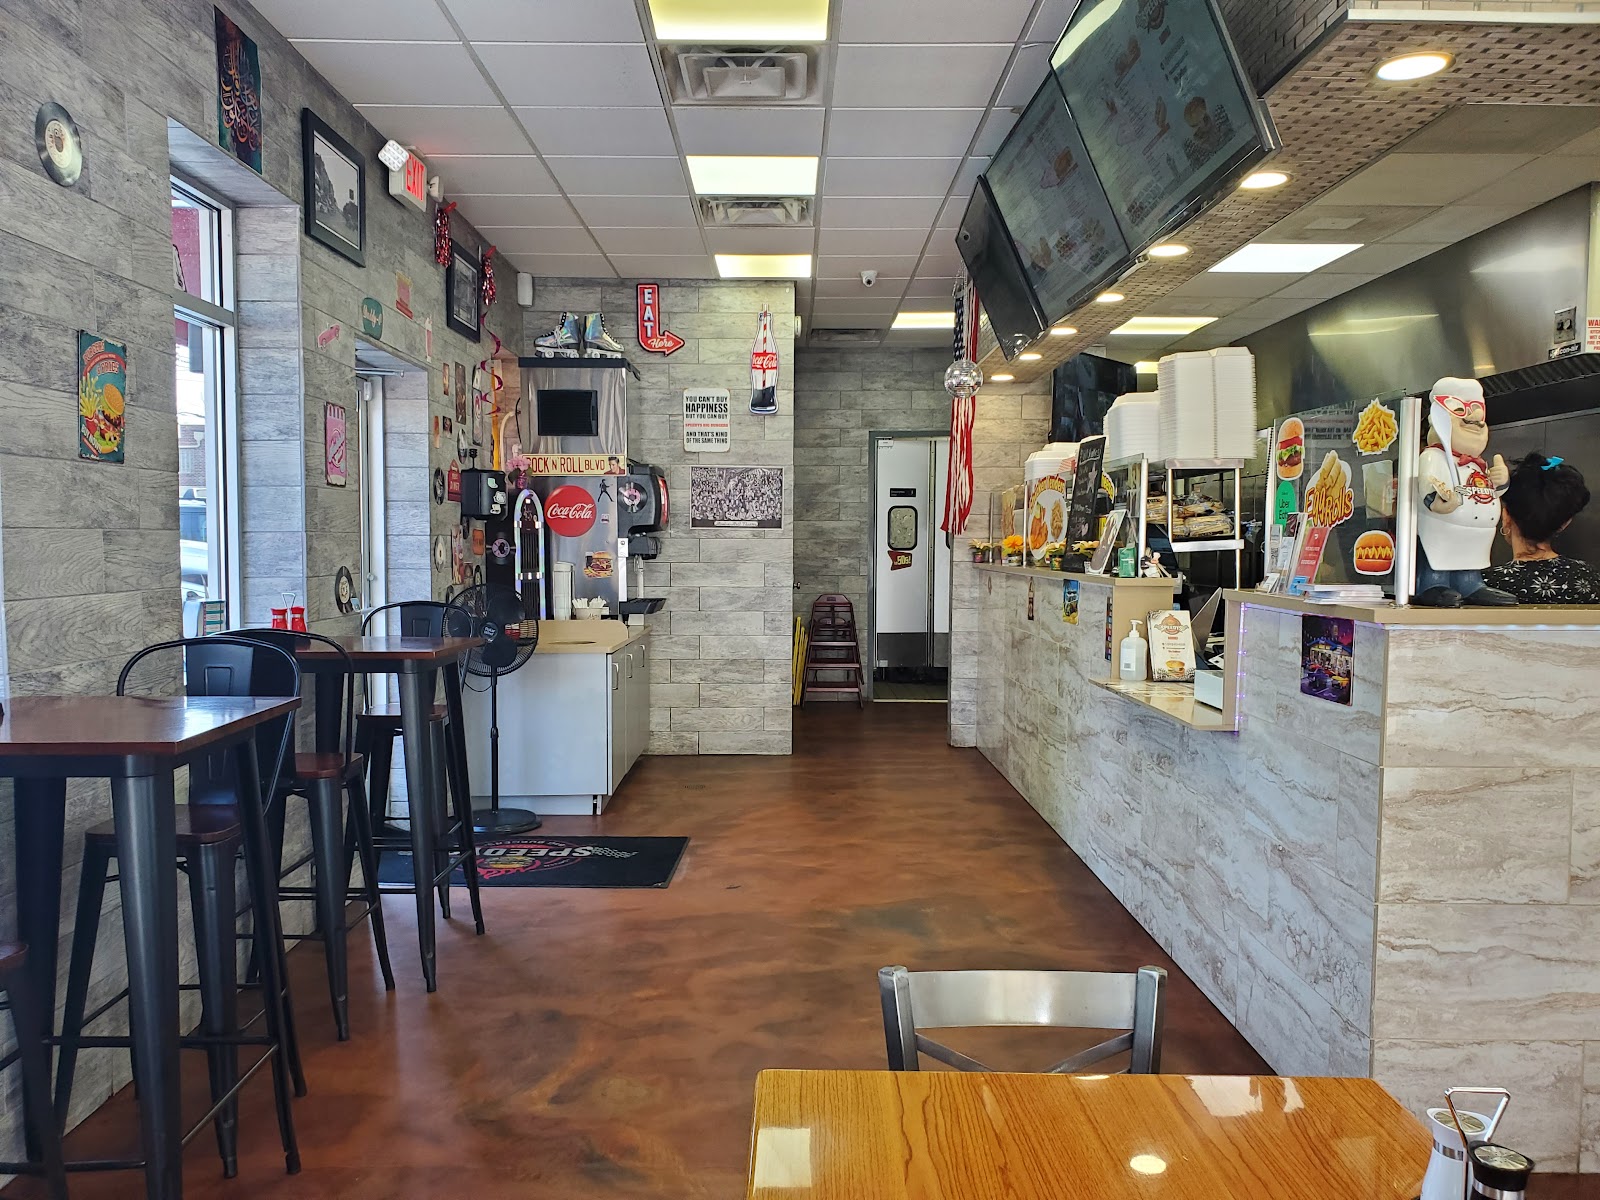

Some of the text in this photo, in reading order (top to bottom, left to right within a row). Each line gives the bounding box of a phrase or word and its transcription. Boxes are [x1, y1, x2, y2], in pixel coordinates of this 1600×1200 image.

[405, 153, 425, 201] EXIT
[643, 288, 655, 338] EAT
[647, 338, 674, 348] Here
[685, 403, 728, 413] HAPPINESS
[560, 457, 584, 473] ROLL
[585, 459, 605, 471] BLVD
[546, 503, 595, 519] Coca-Cola
[1279, 498, 1290, 509] Uber
